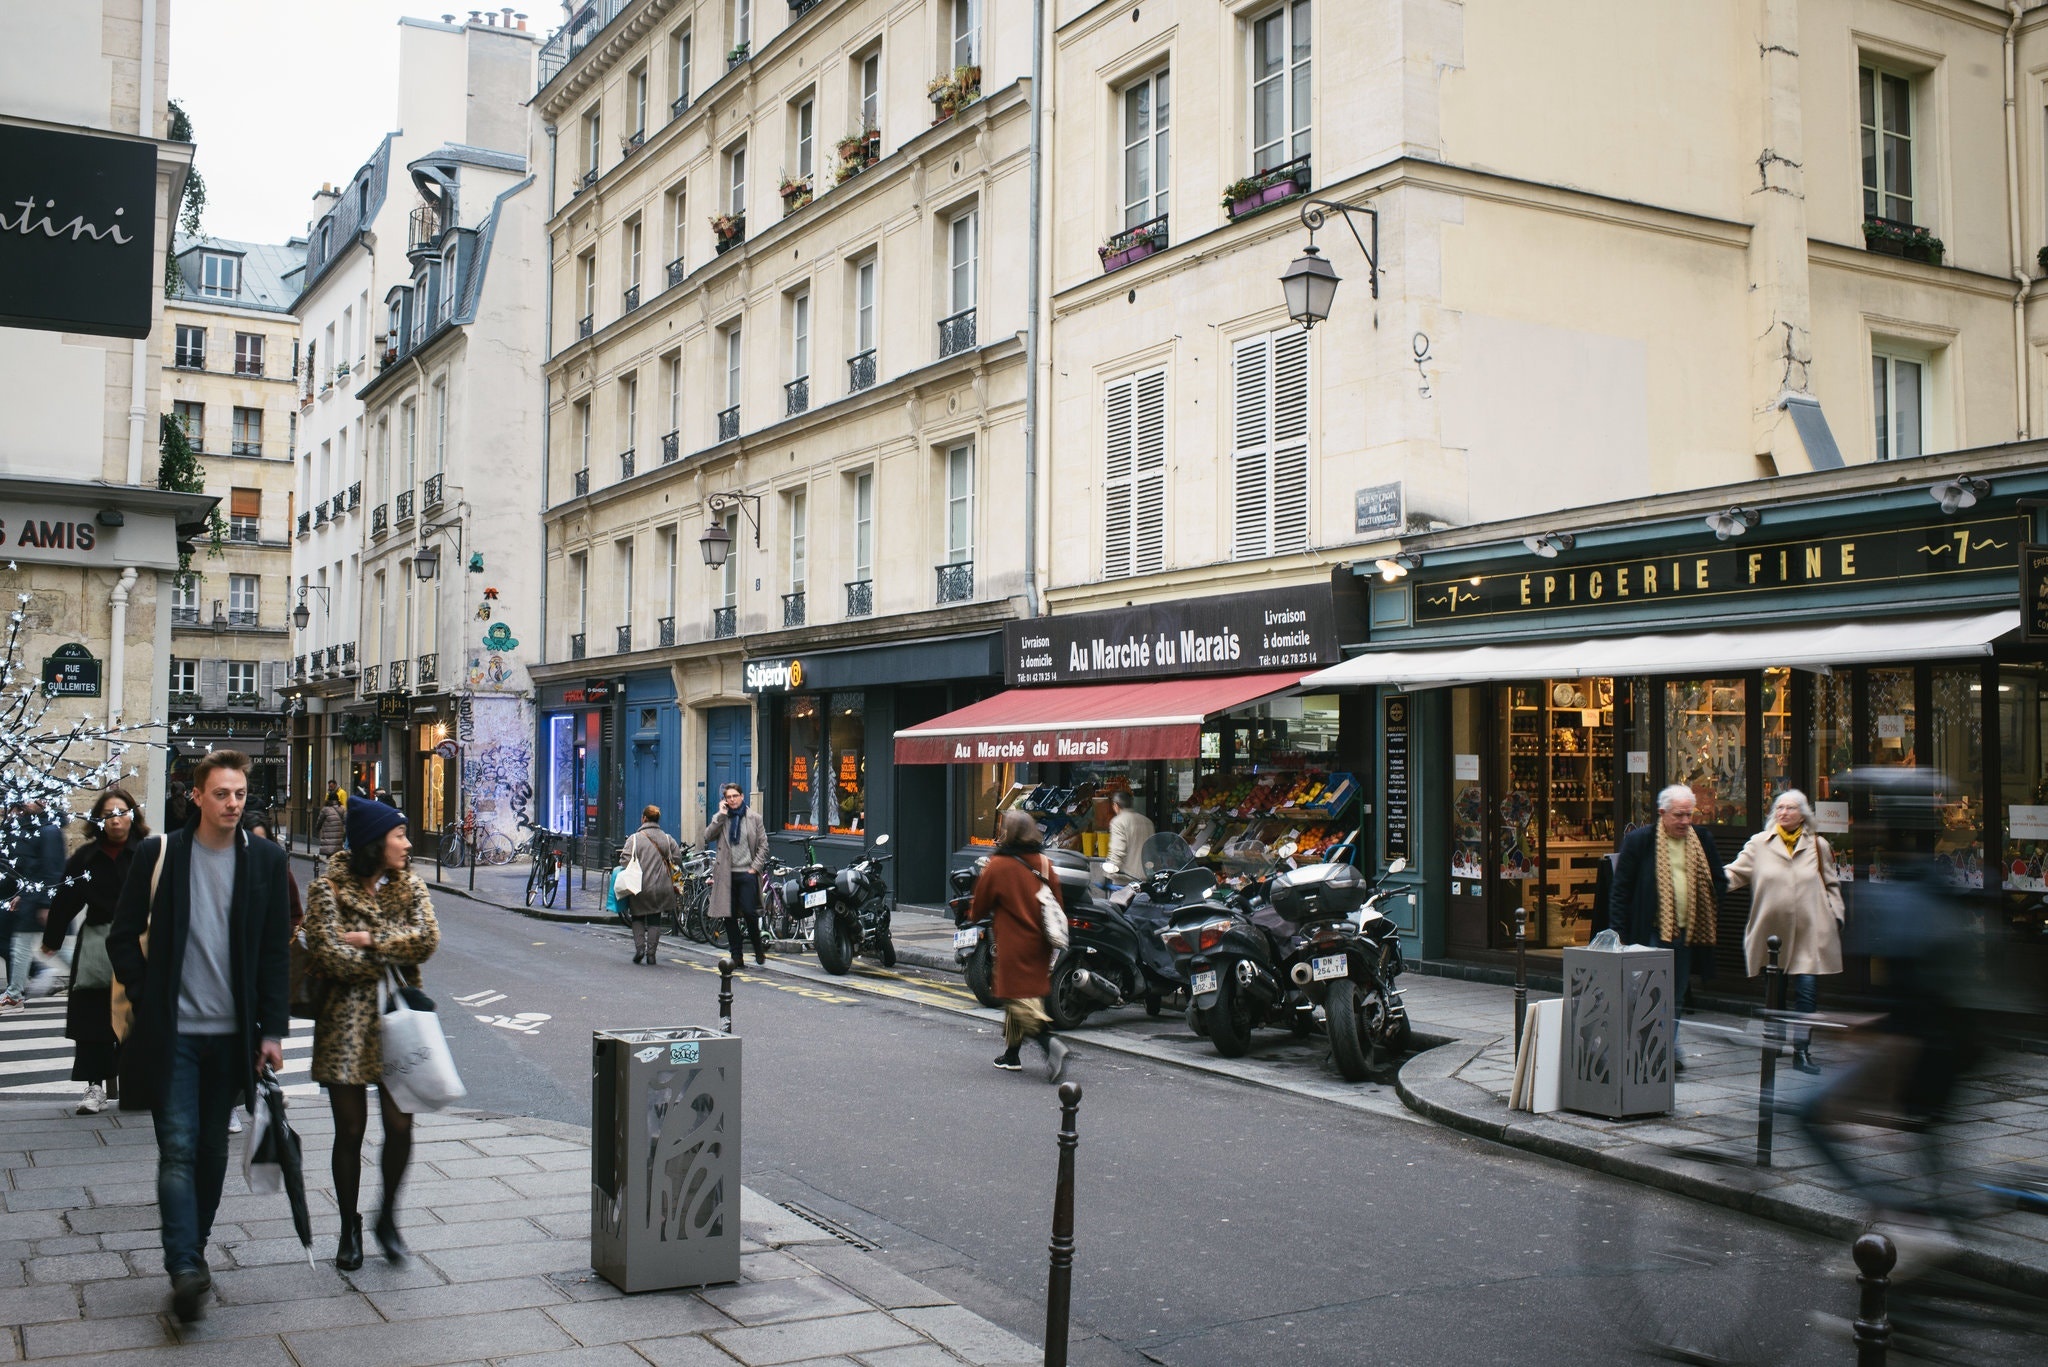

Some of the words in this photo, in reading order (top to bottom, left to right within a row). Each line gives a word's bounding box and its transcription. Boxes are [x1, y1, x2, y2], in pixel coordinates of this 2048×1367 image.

[17, 519, 96, 551] AMIS
[1520, 559, 1710, 606] ÉPICERIE
[1748, 543, 1857, 585] FINE
[1264, 608, 1306, 626] Livraison
[1021, 635, 1050, 650] Livraison
[1263, 634, 1269, 649] à
[1271, 629, 1310, 648] domicile
[1070, 641, 1088, 672] Au
[1092, 634, 1150, 670] Marché
[1155, 633, 1175, 666] du
[1180, 627, 1240, 664] Marais
[1020, 656, 1025, 668] à
[1026, 653, 1053, 668] domicile
[1272, 655, 1279, 665] 01
[1281, 655, 1289, 665] 42
[1290, 653, 1299, 664] 78
[1299, 652, 1308, 663] 25
[1309, 652, 1317, 664] 14
[65, 664, 80, 673] RUE
[48, 681, 96, 691] GUILLEMITES
[954, 742, 971, 758] Au
[978, 740, 1025, 758] Marché
[1032, 740, 1049, 757] du
[1058, 737, 1109, 756] Marais
[841, 763, 856, 772] SOLDES
